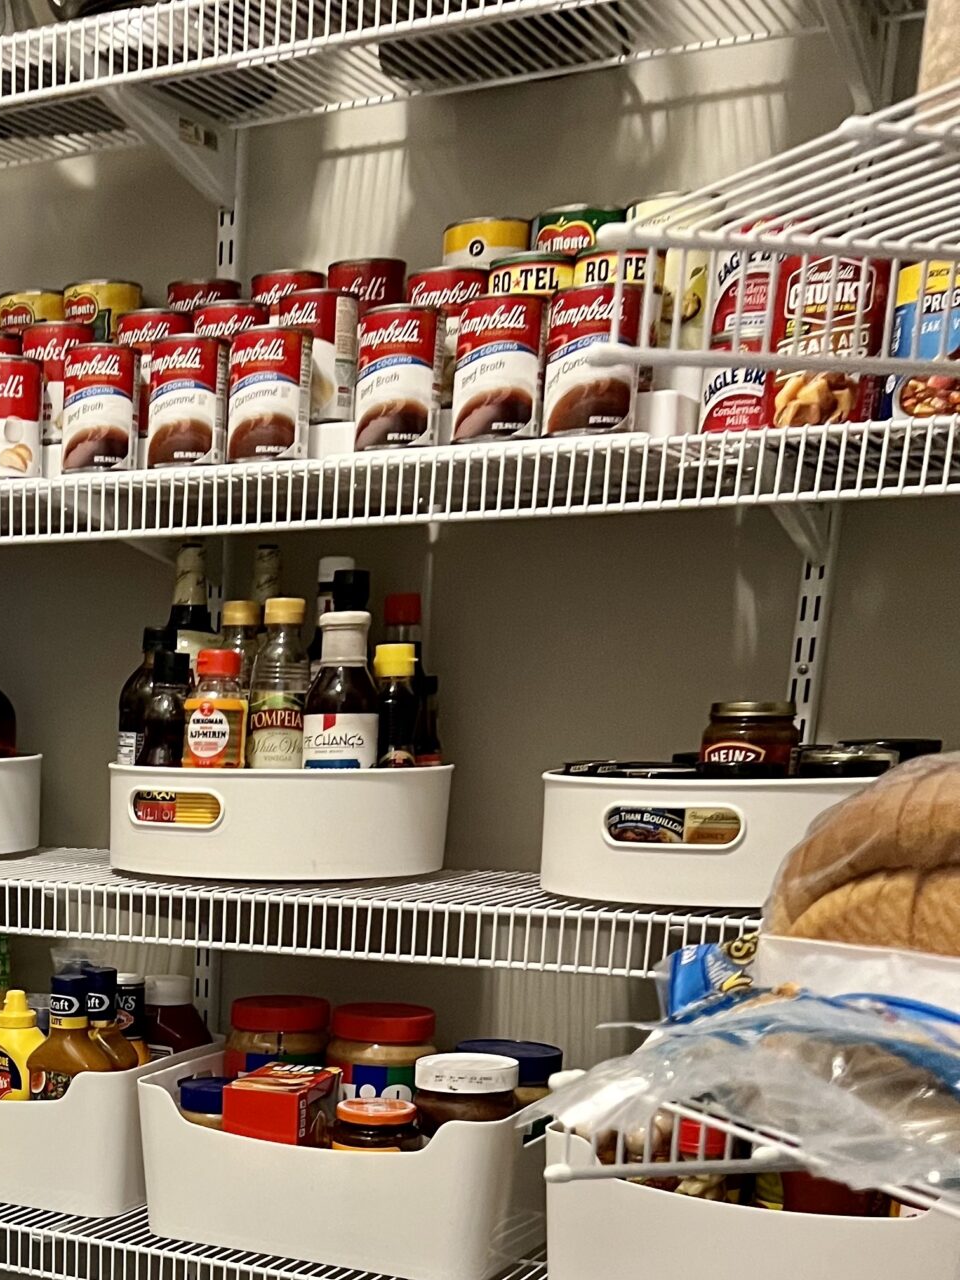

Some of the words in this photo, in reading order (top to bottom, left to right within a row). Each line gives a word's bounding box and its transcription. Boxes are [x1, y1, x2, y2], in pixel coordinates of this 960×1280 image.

[585, 259, 607, 283] RO
[492, 269, 513, 293] RO
[521, 266, 560, 291] TEL
[72, 304, 95, 316] Monte
[7, 313, 31, 324] Monte
[480, 342, 518, 357] COOKING
[376, 356, 412, 369] COOKING
[479, 359, 505, 375] Broth
[245, 372, 278, 385] COOKING
[376, 372, 400, 388] Broth
[81, 387, 114, 398] COOKING
[163, 380, 195, 392] COOKING
[82, 402, 104, 414] Broth
[250, 711, 303, 729] POMPEIA
[251, 736, 279, 754] White
[710, 749, 756, 763] HEINZ
[620, 812, 642, 821] THAN
[642, 812, 684, 834] BOUILLON
